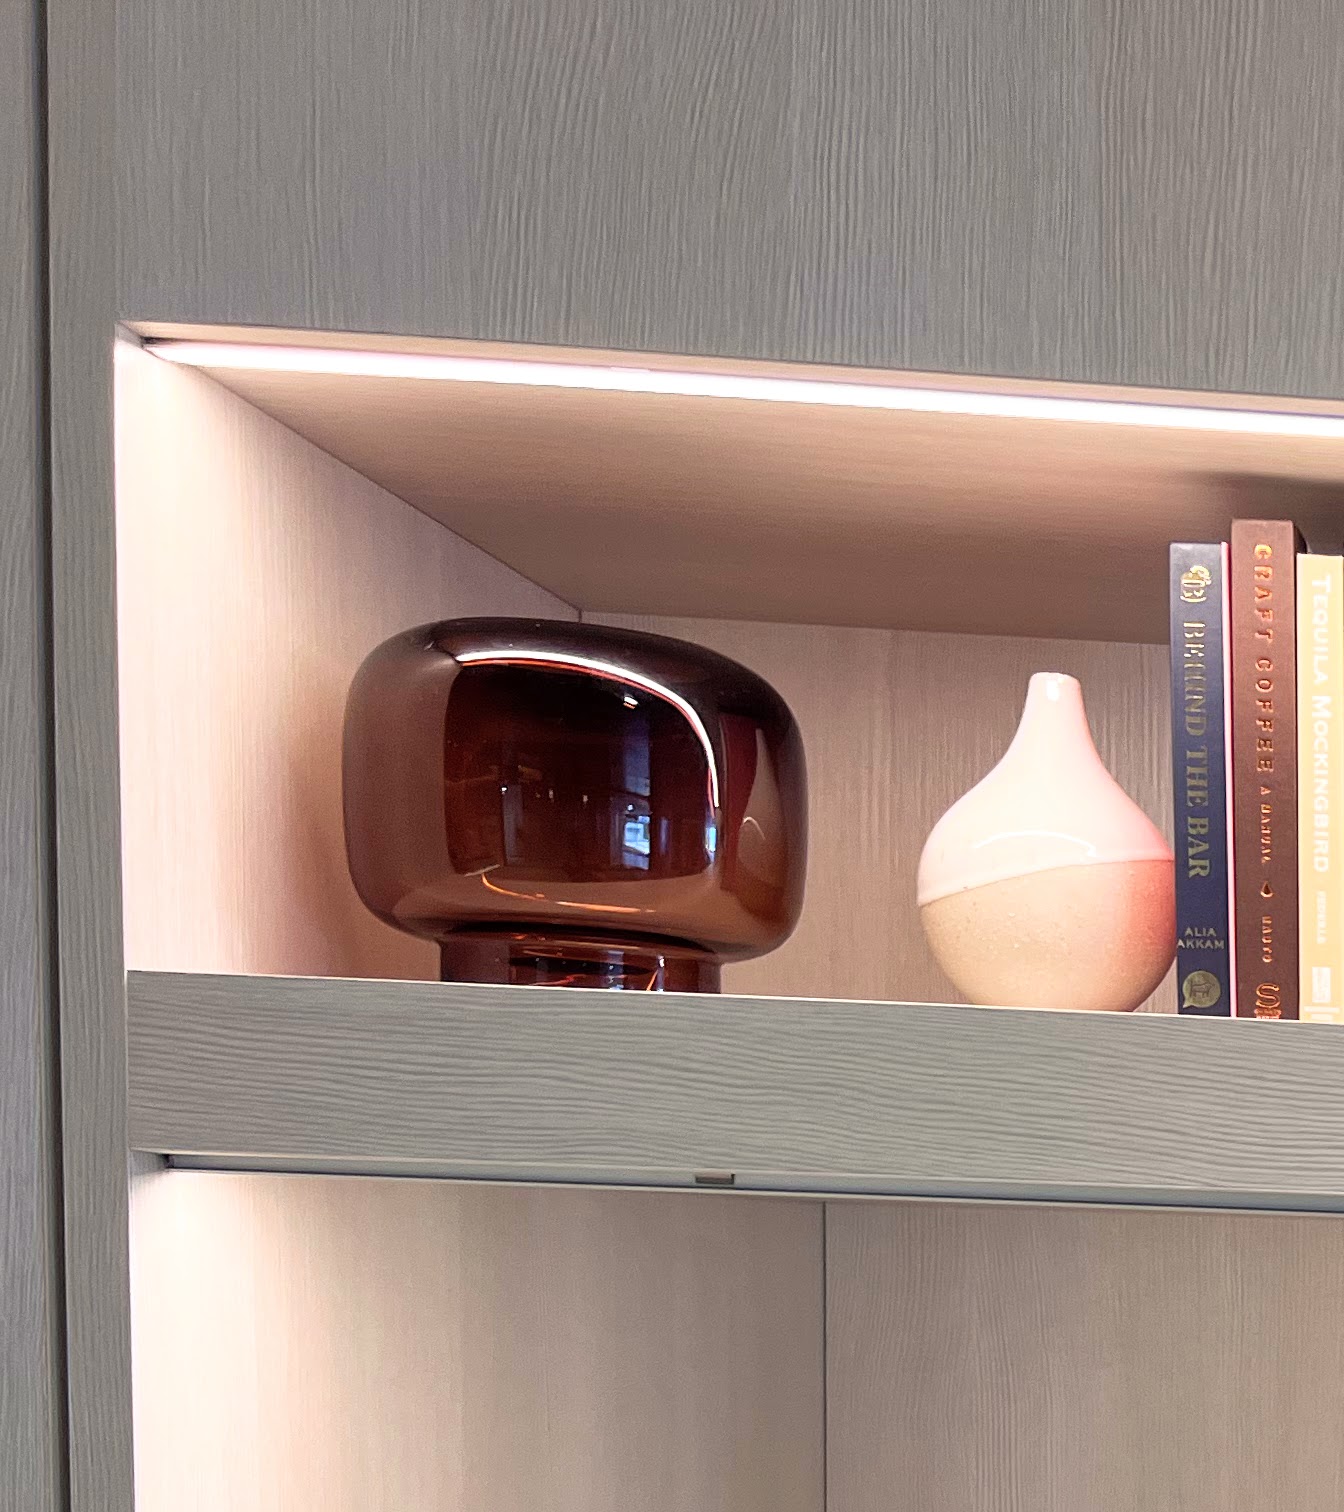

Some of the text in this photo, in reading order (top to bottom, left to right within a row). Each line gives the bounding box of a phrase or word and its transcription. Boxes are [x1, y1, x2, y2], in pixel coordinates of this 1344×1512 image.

[1254, 543, 1274, 644] CRAFT
[1183, 621, 1211, 879] BEHIND THE BAR
[1255, 658, 1275, 773] COFFEE
[1177, 938, 1225, 950] AKKAM
[1184, 926, 1217, 938] ALIA
